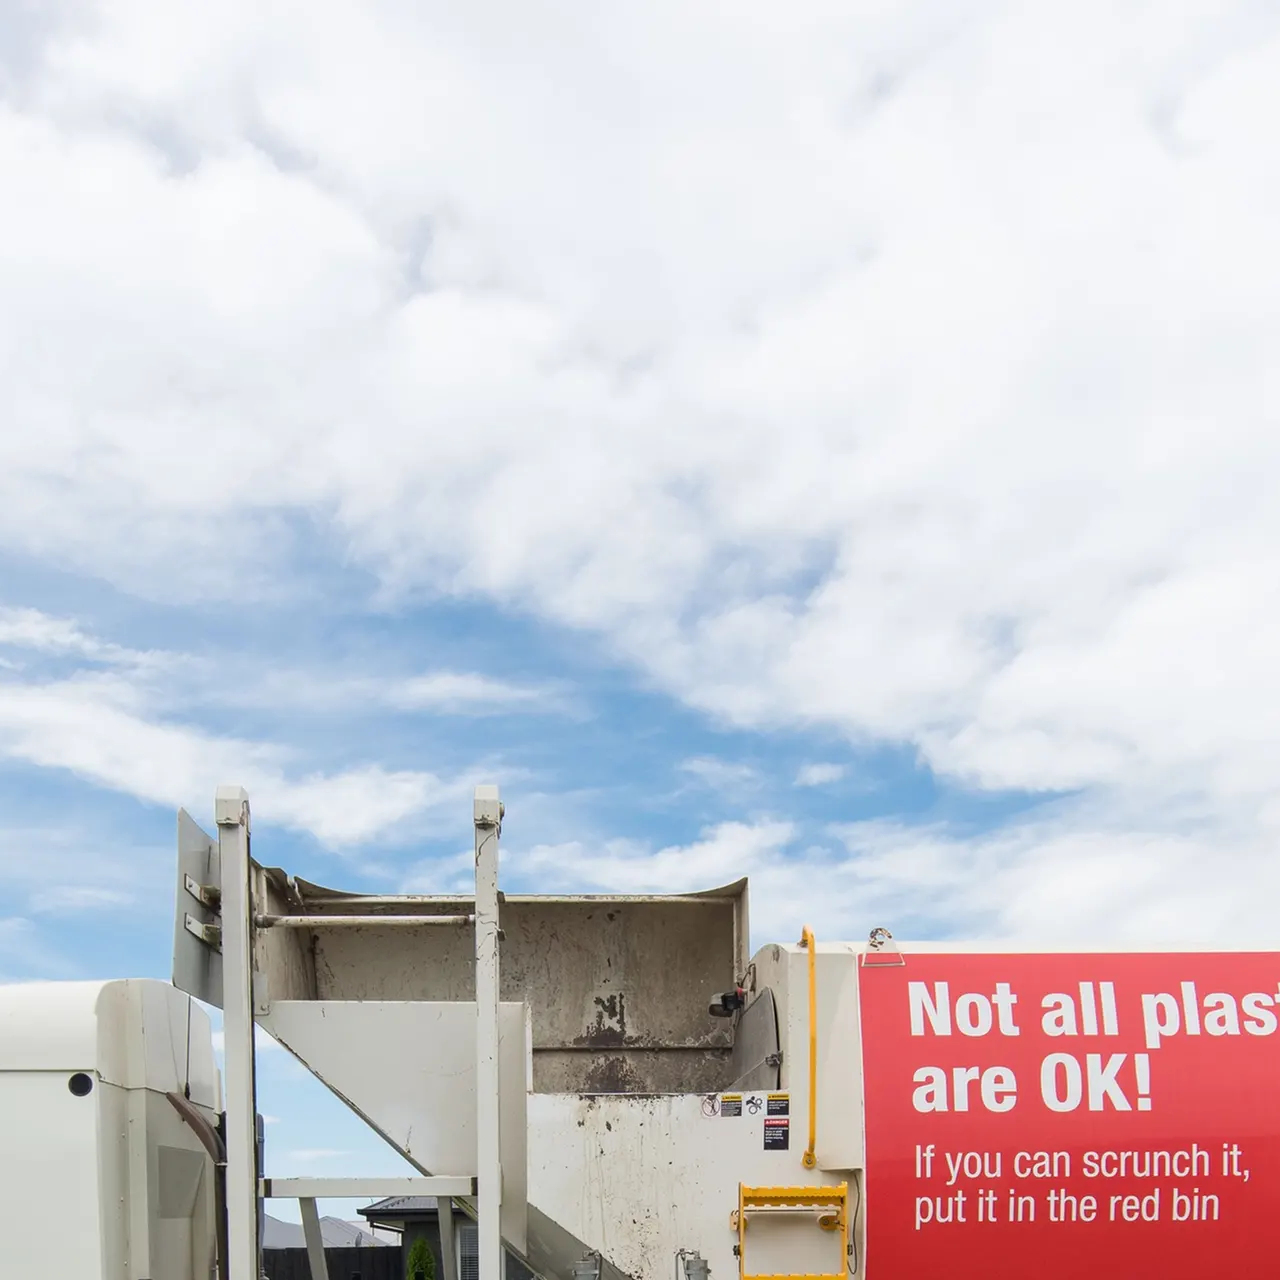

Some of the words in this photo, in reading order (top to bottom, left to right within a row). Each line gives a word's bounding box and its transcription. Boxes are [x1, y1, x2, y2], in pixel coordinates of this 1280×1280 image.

[908, 981, 1020, 1037] Not
[1041, 981, 1119, 1037] all
[912, 1066, 1017, 1113] are
[1040, 1052, 1152, 1113] OK!
[915, 1144, 935, 1178] If
[945, 1151, 1001, 1186] you
[1014, 1151, 1070, 1178] can
[1082, 1143, 1209, 1178] scrunch
[1223, 1143, 1250, 1182] it,
[915, 1190, 967, 1230] put
[978, 1188, 998, 1222] it
[1009, 1188, 1035, 1222] in
[1046, 1188, 1097, 1222] the
[1110, 1187, 1160, 1222] red
[1172, 1187, 1219, 1221] bin
